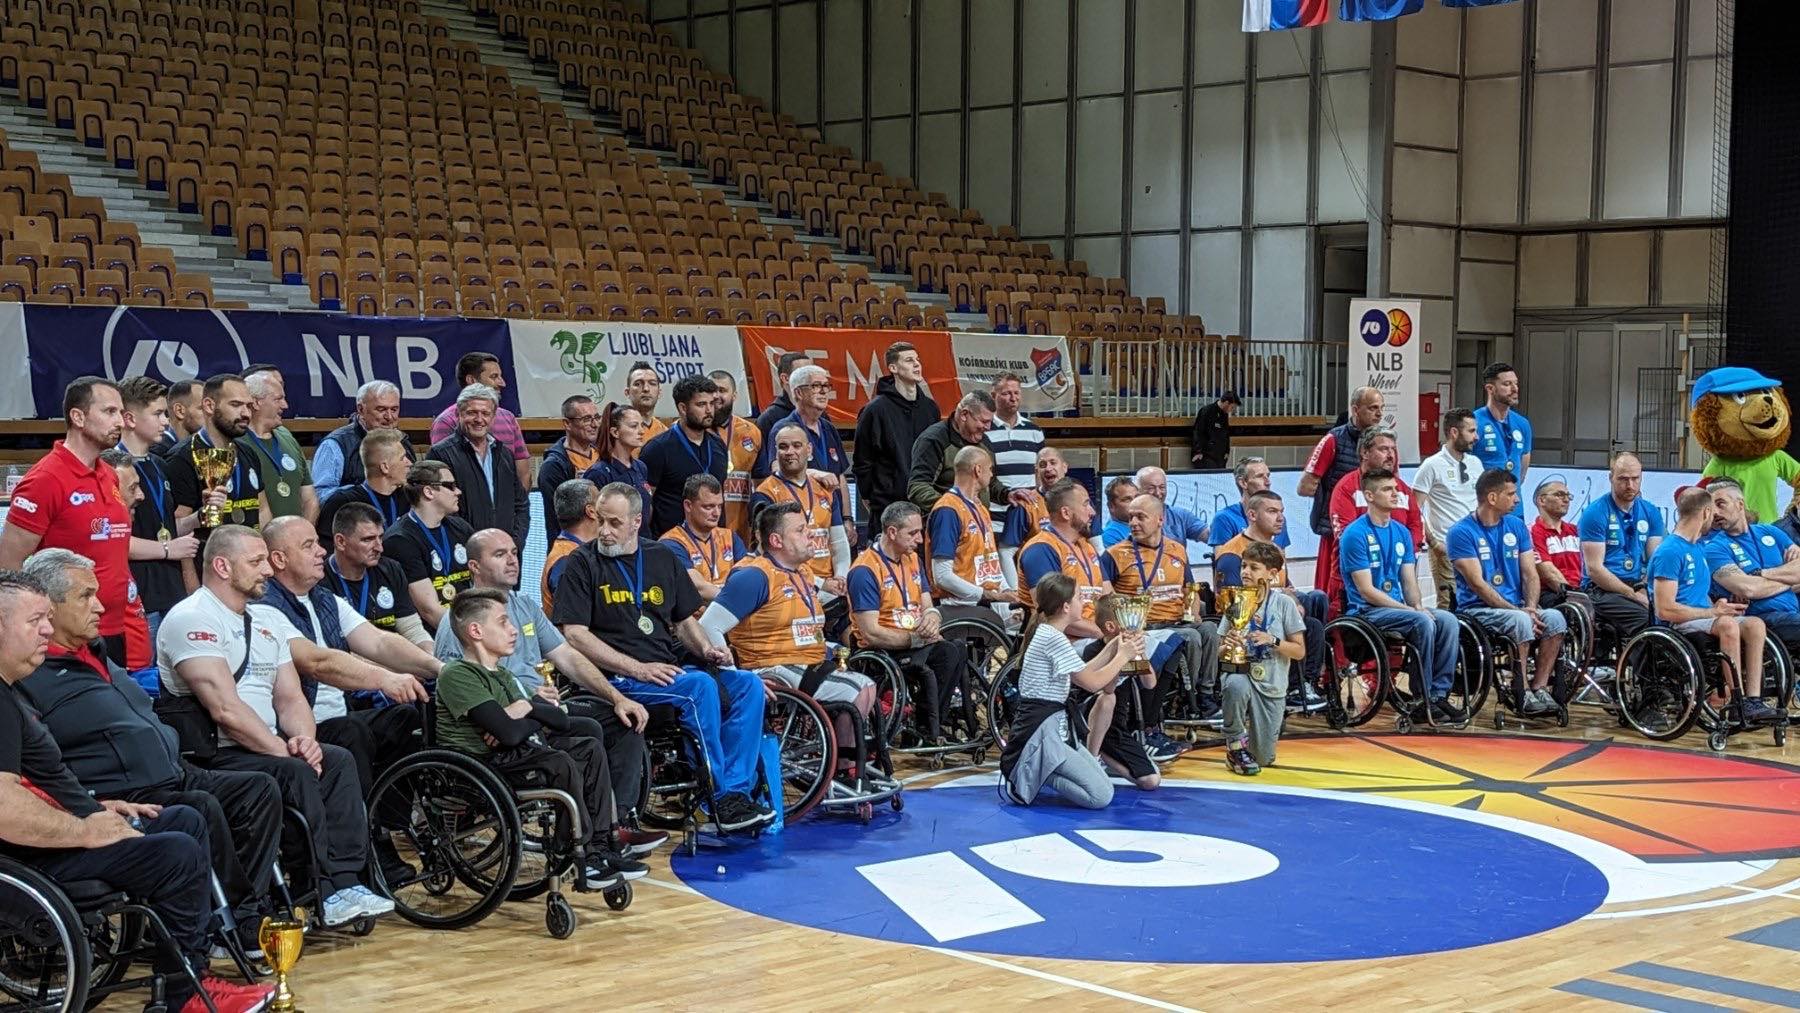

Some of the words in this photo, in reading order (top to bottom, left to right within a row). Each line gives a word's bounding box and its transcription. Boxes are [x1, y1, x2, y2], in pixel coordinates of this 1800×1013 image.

[607, 332, 702, 358] LJUBLJANA
[301, 333, 443, 399] NLB
[655, 358, 704, 384] ŠPORT
[1367, 352, 1403, 371] NLB
[1367, 373, 1402, 390] Wheel
